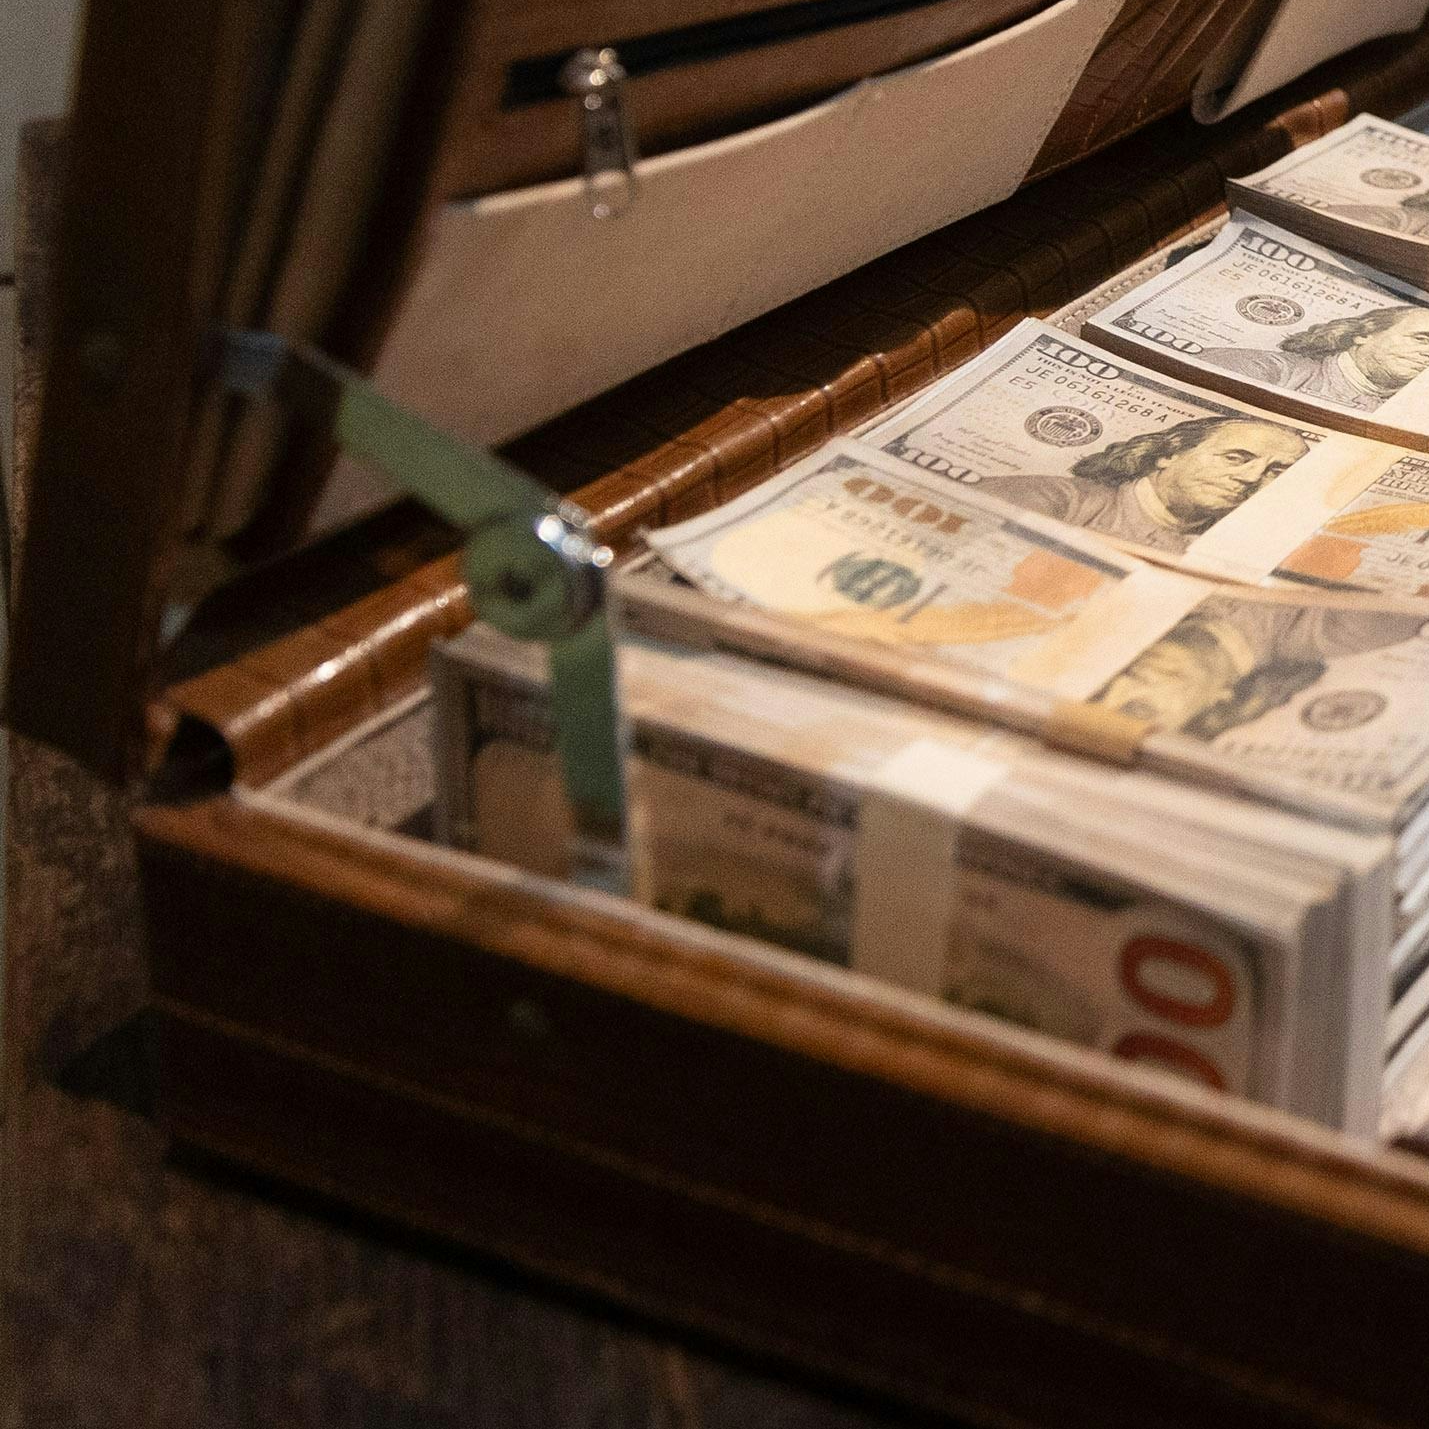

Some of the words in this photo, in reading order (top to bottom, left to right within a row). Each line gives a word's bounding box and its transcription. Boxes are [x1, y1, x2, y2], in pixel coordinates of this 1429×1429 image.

[1240, 235, 1317, 272] 100
[1255, 268, 1350, 305] 06161268
[1348, 301, 1364, 310] A
[1133, 321, 1204, 355] 100
[1036, 342, 1123, 380] 100
[1006, 375, 1038, 390] E5
[1022, 363, 1054, 379] JE
[1052, 375, 1156, 418] 06161268
[1153, 412, 1171, 423] A
[1035, 356, 1065, 370] THIS
[1078, 373, 1103, 385] NOT
[1112, 386, 1148, 401] LEGAL
[1149, 400, 1197, 418] TENDER
[899, 446, 983, 485] 100
